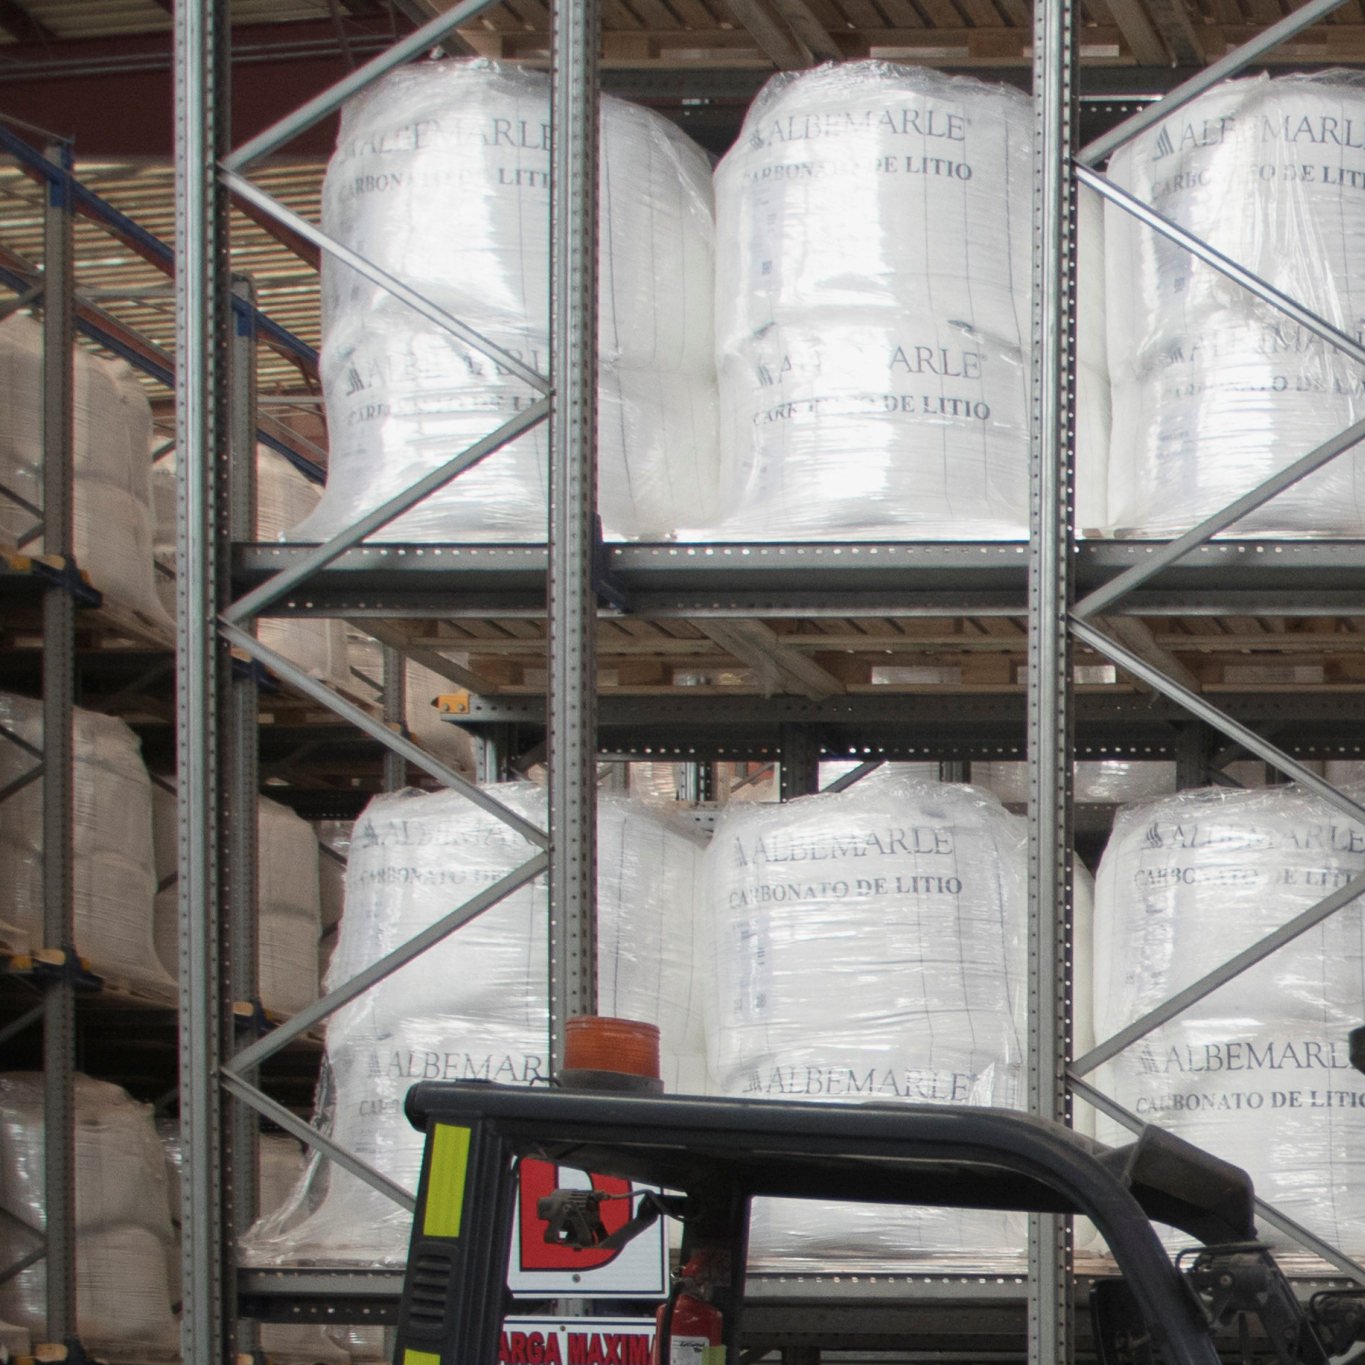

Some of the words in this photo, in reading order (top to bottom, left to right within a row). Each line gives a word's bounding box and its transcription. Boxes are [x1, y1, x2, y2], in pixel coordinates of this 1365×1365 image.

[498, 167, 550, 188] LITI
[906, 156, 974, 181] LITIO
[884, 395, 915, 414] DE
[922, 398, 992, 421] LITIO
[757, 826, 954, 863] ALBEMARLE
[1306, 867, 1353, 888] LITI
[729, 881, 850, 909] CARBONATO
[856, 877, 890, 896] DE
[895, 876, 964, 896] LITIO
[389, 1050, 546, 1082] ALBEMAR
[1164, 1041, 1360, 1072] ALBEMARL
[766, 1065, 970, 1101] ALBEMARLE
[1271, 1091, 1303, 1108] DE
